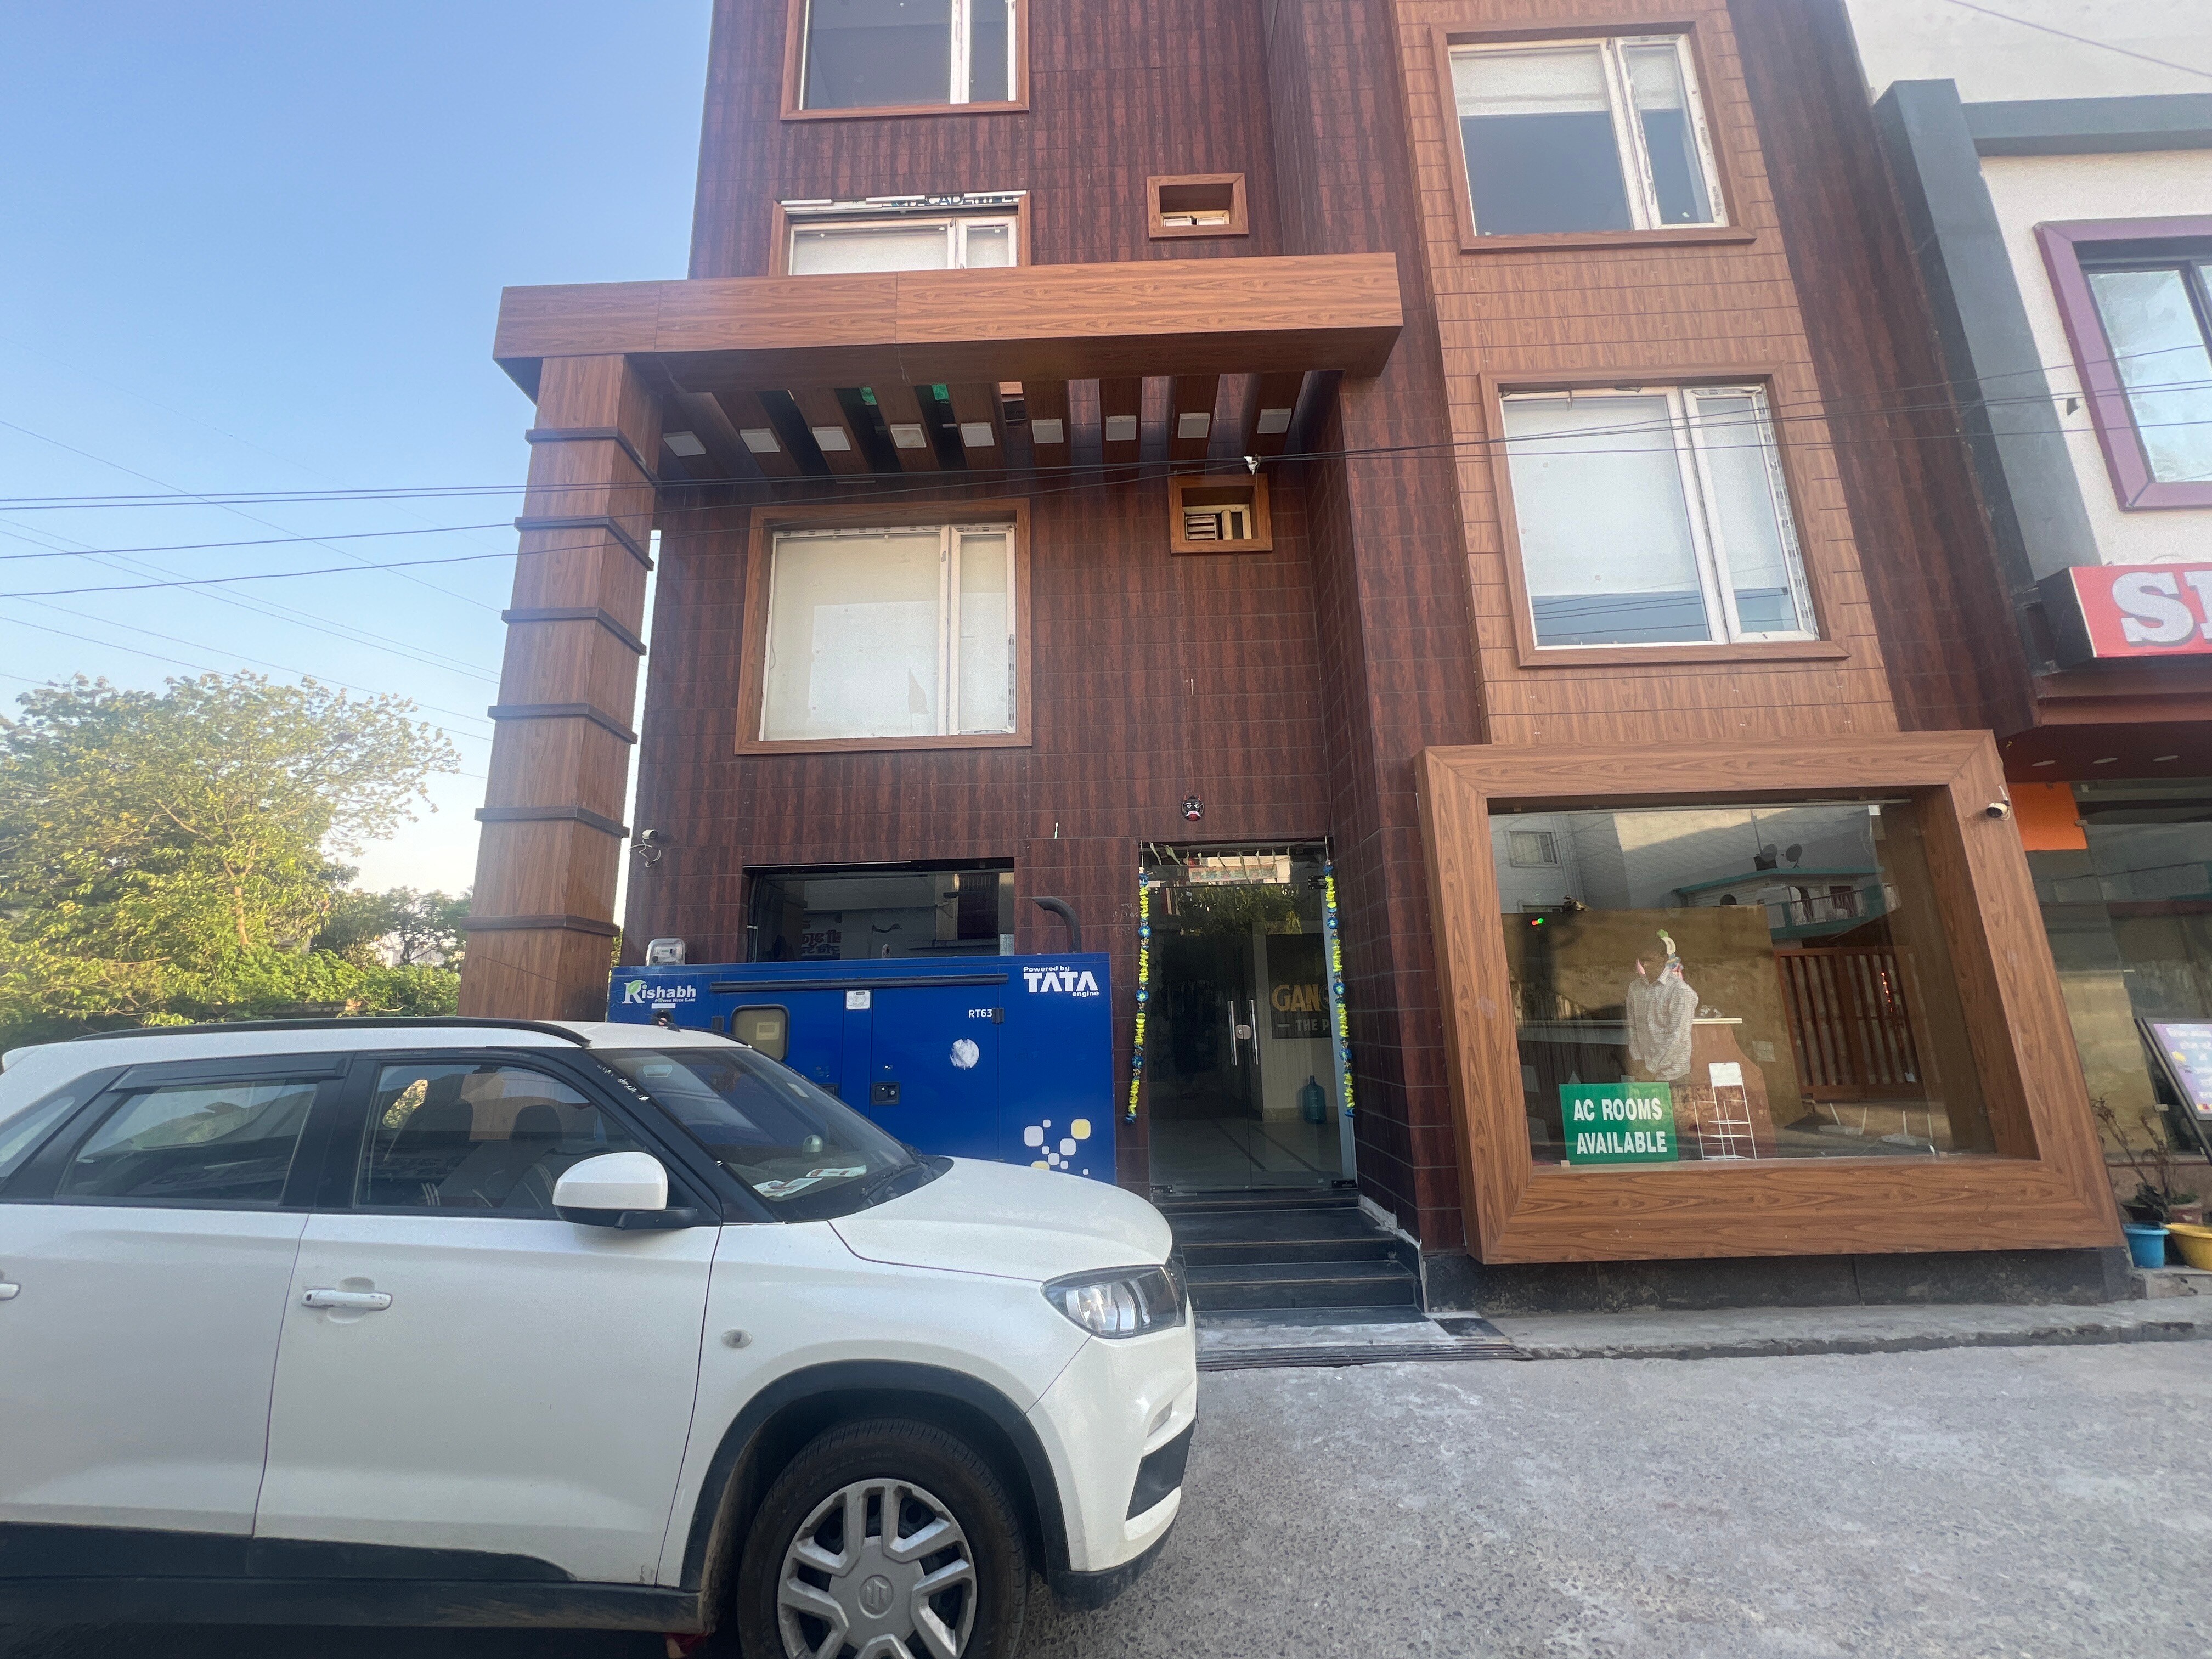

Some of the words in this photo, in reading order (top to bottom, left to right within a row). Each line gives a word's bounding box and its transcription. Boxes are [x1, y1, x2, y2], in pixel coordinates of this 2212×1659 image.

[622, 979, 696, 1004] Rishabh
[1023, 971, 1098, 992] TATA
[968, 1008, 992, 1018] RT63
[1295, 1019, 1318, 1031] THE
[1573, 1098, 1595, 1121] AC
[1601, 1098, 1662, 1121] ROOMS
[1576, 1131, 1667, 1154] AVAILABLE
